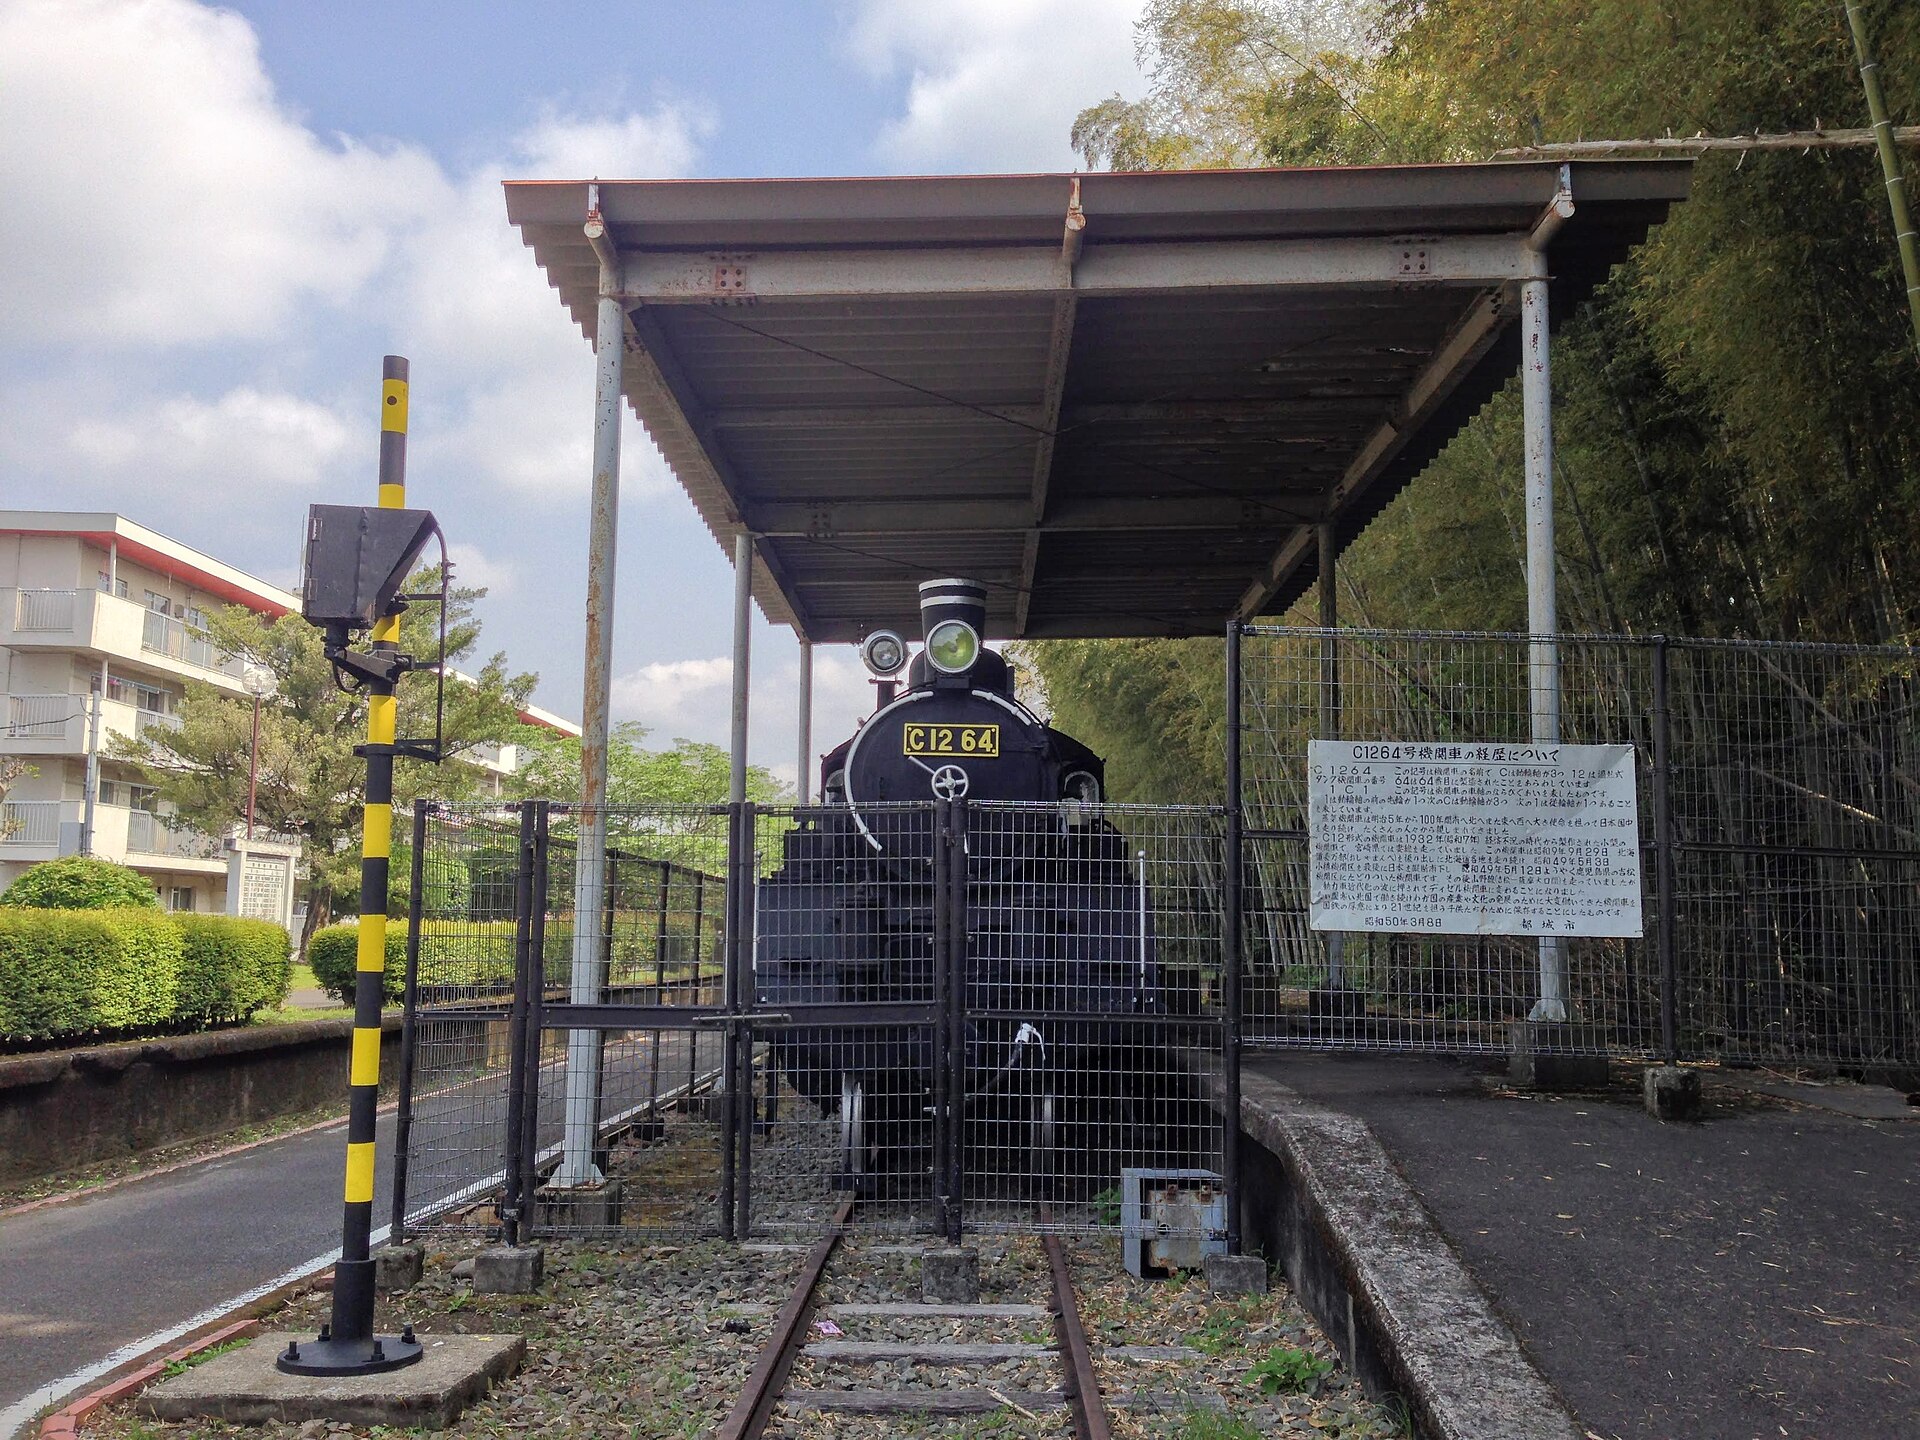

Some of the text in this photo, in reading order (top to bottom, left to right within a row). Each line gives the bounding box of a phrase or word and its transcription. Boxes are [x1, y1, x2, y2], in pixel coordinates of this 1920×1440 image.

[1353, 745, 1560, 763] C1264号機関車の経歴について
[1364, 917, 1442, 929] 昭和50年3月8日
